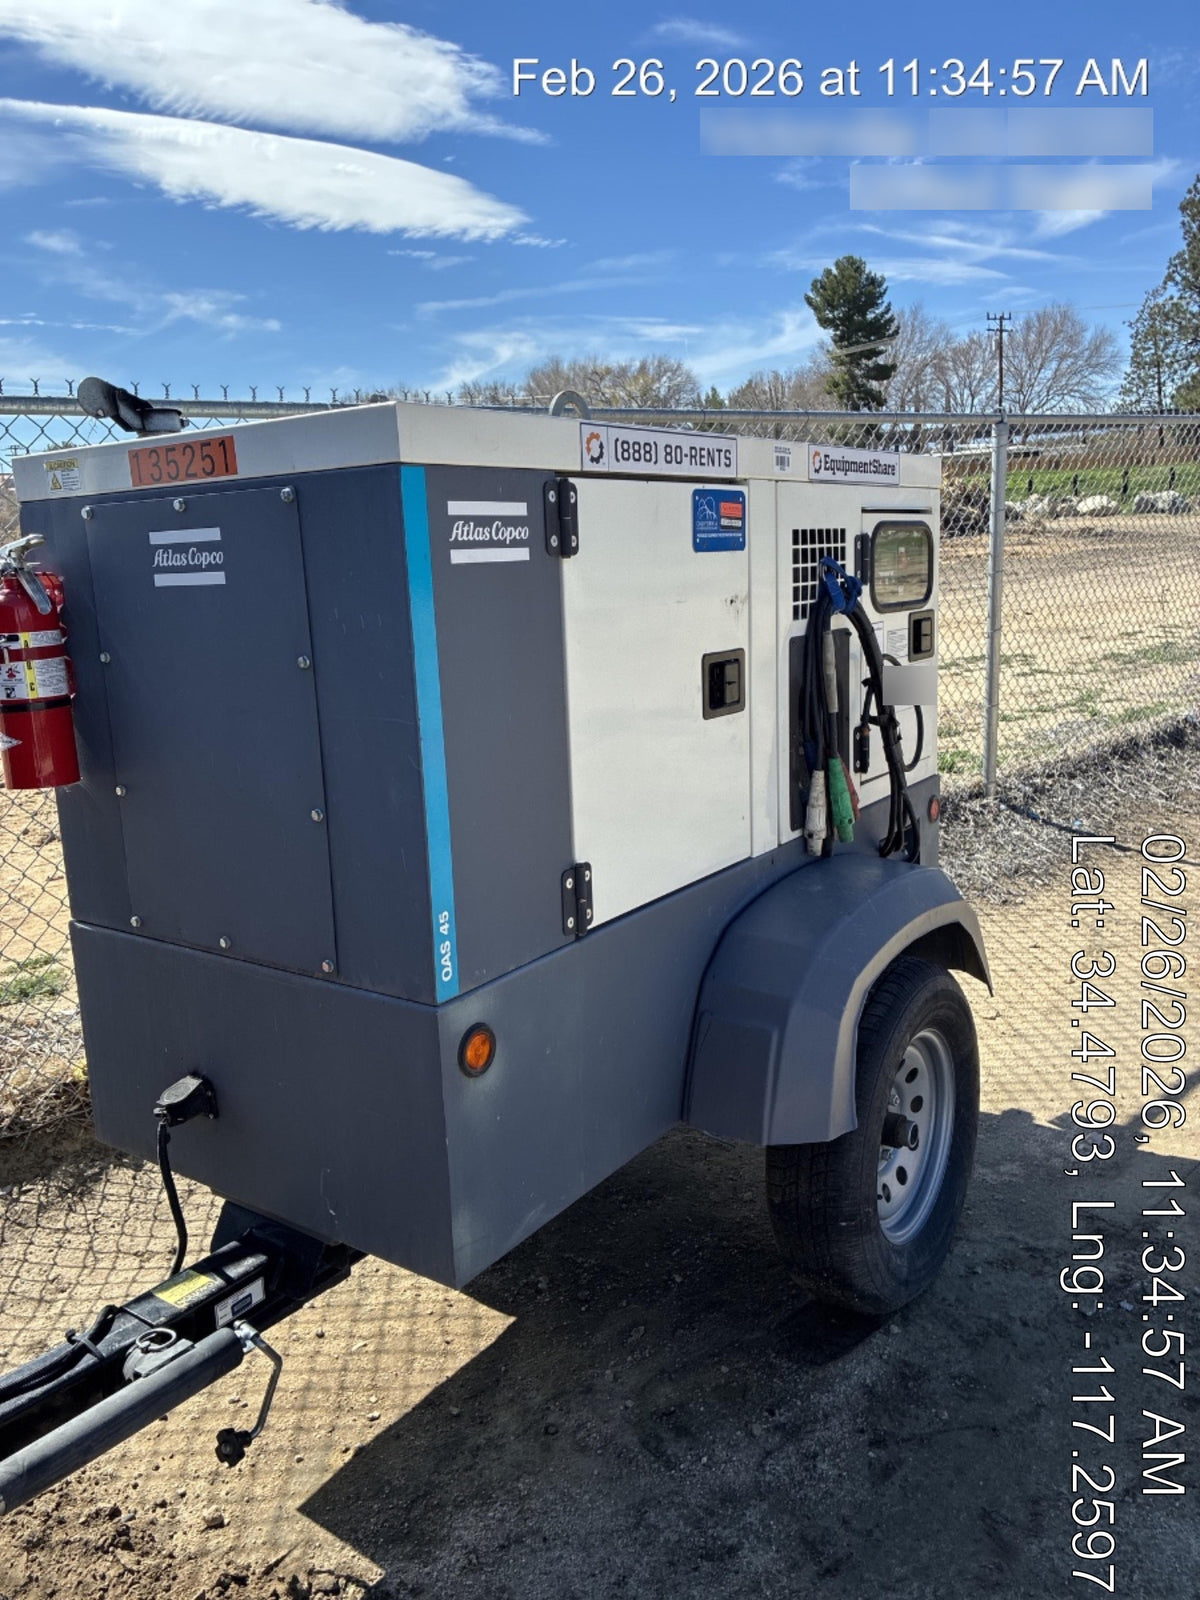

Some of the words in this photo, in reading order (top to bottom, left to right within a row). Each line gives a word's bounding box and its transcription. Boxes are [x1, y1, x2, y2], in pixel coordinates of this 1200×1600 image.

[132, 439, 229, 482] 135251
[614, 437, 658, 465] (888)
[664, 444, 732, 468] 80-RENTS
[823, 454, 896, 476] EquipmentShare
[449, 520, 490, 542] Atlas
[491, 520, 529, 545] Copco
[152, 548, 187, 567] Atlas
[188, 547, 224, 569] Copco
[438, 910, 449, 935] 45
[440, 940, 452, 982] OAS
